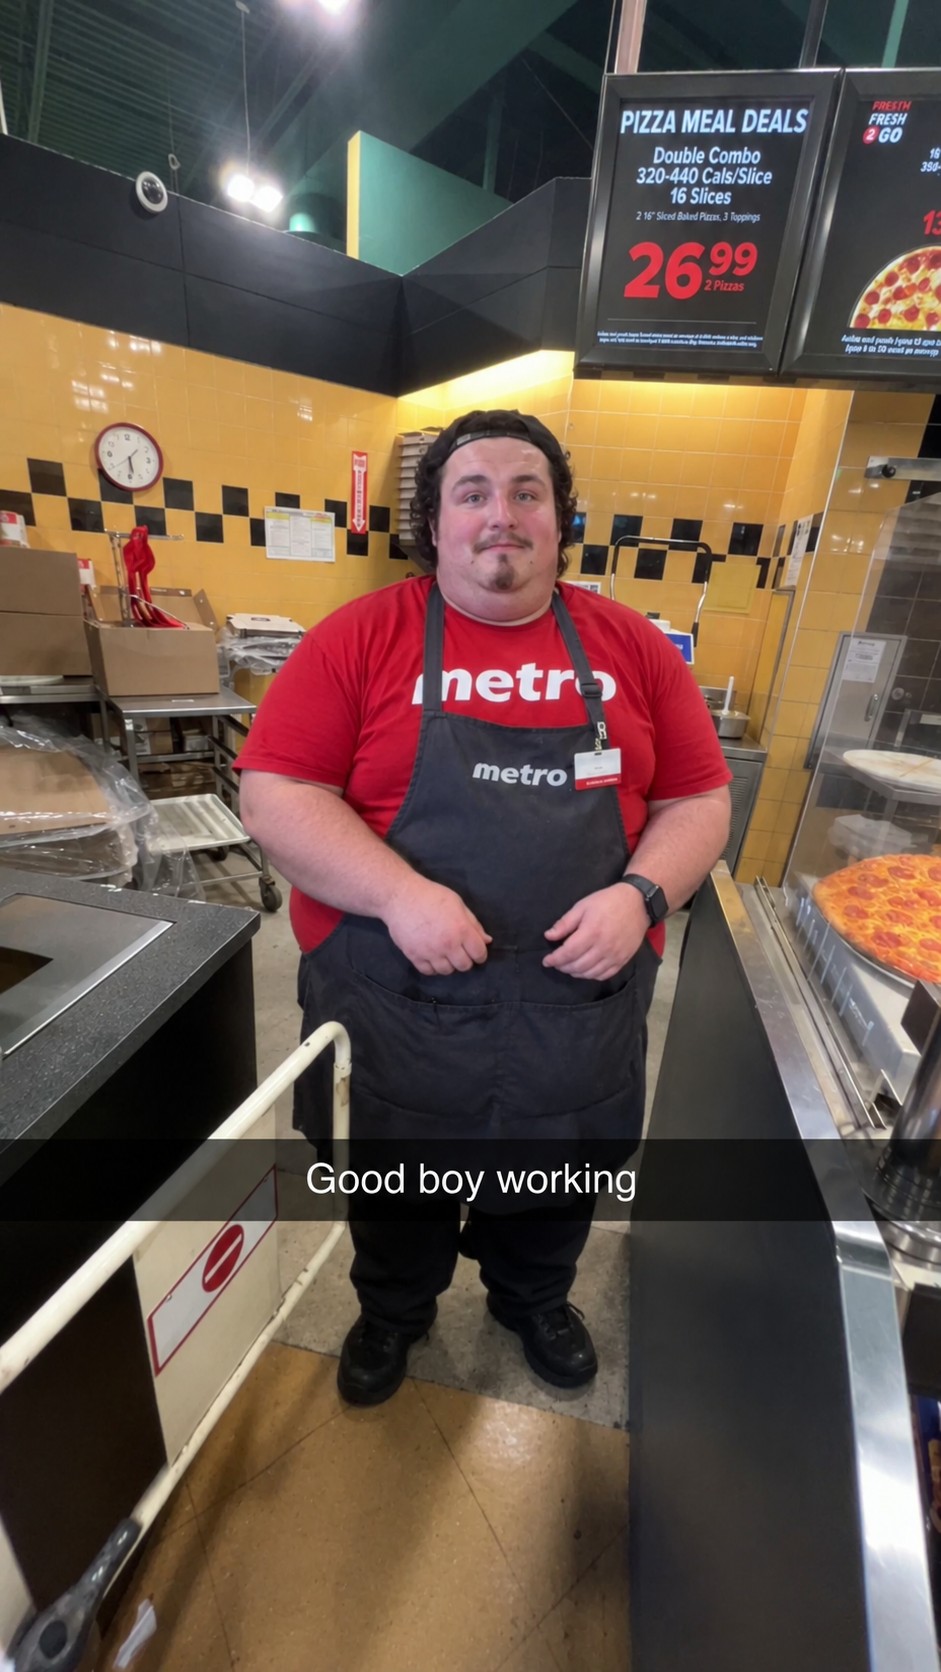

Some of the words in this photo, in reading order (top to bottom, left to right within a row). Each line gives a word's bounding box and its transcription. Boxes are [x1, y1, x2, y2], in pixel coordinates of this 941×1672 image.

[620, 110, 676, 134] PIZZA
[681, 109, 736, 133] MEAL
[741, 108, 809, 133] DEALS
[868, 112, 908, 126] FRESH
[865, 128, 876, 141] 2
[878, 126, 903, 143] GO
[653, 146, 705, 164] Double
[708, 146, 761, 164] Combo
[636, 167, 699, 185] 320-440
[702, 167, 773, 185] Cals/Slice
[670, 187, 687, 204] 16
[690, 187, 732, 205] Slices
[636, 212, 642, 221] 2
[723, 212, 729, 222] 3
[730, 212, 761, 224] Toppings
[923, 210, 941, 235] 13
[624, 241, 705, 300] 26
[708, 241, 758, 277] 99
[704, 280, 712, 291] 2
[713, 281, 745, 292] Pizzas
[412, 663, 617, 705] metro
[472, 762, 568, 787] metro
